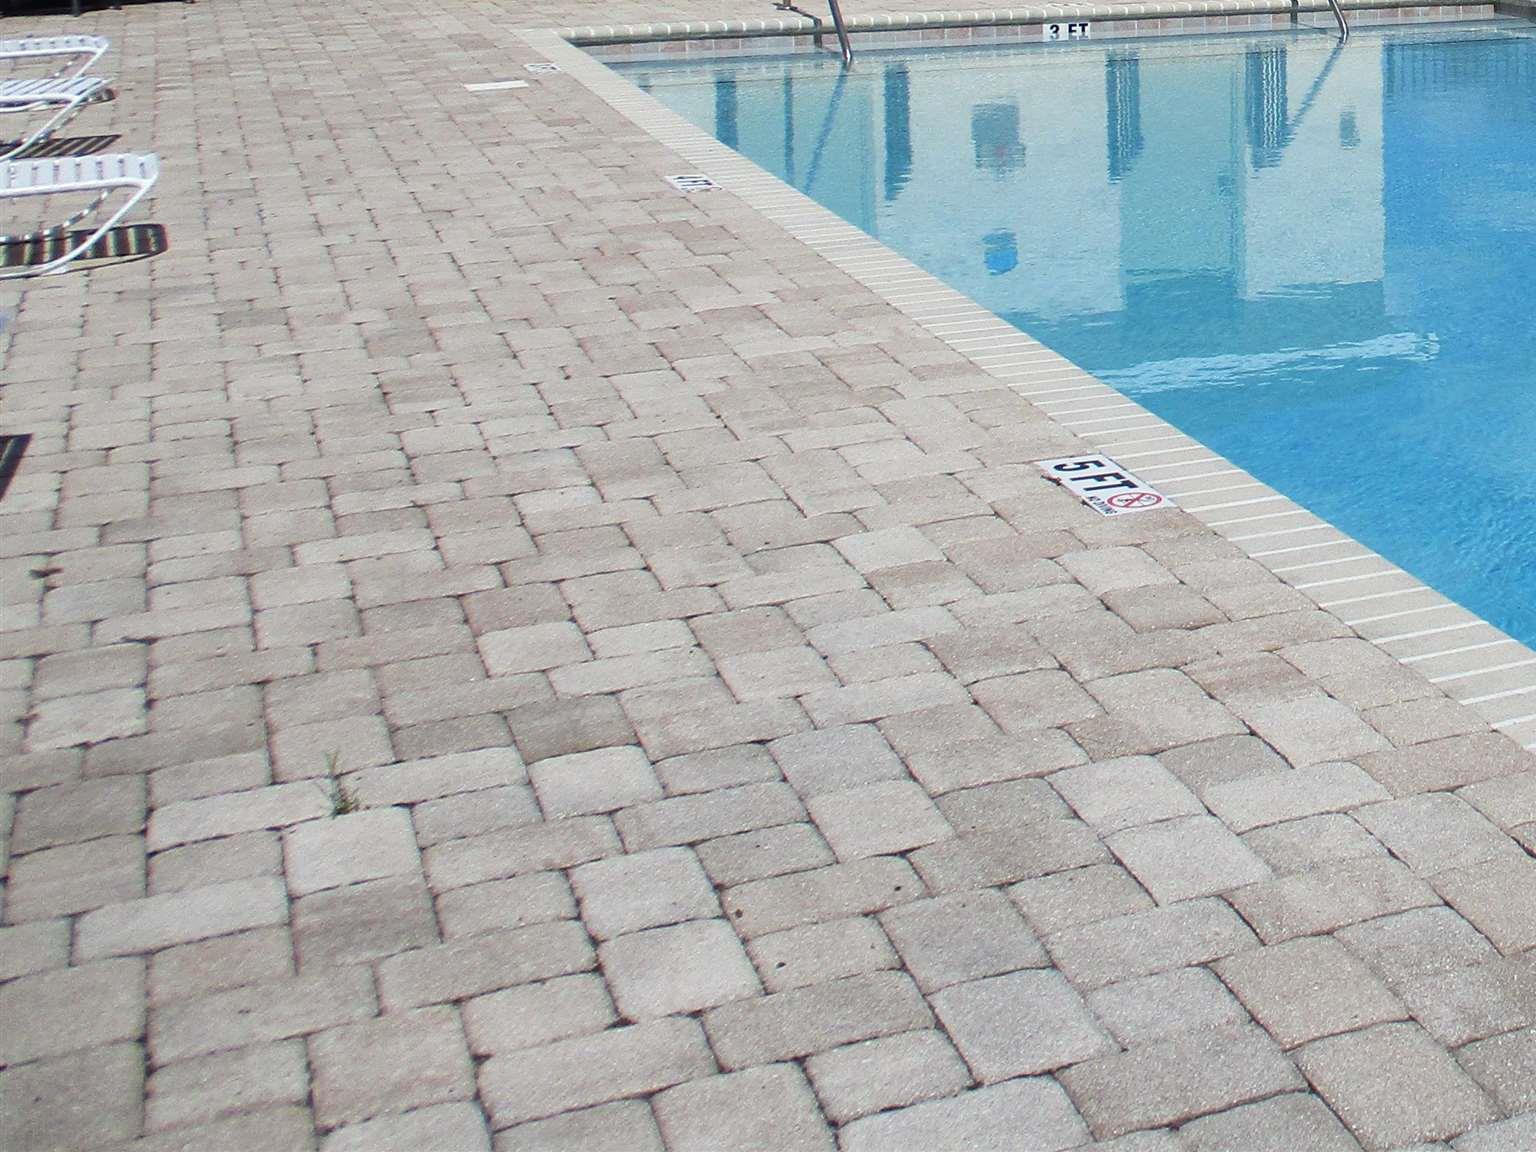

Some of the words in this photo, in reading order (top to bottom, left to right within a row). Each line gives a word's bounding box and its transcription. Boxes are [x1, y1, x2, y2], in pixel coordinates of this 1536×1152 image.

[1049, 24, 1060, 39] 3
[1068, 22, 1089, 39] FT
[1053, 460, 1106, 472] 5
[1070, 471, 1139, 491] FT
